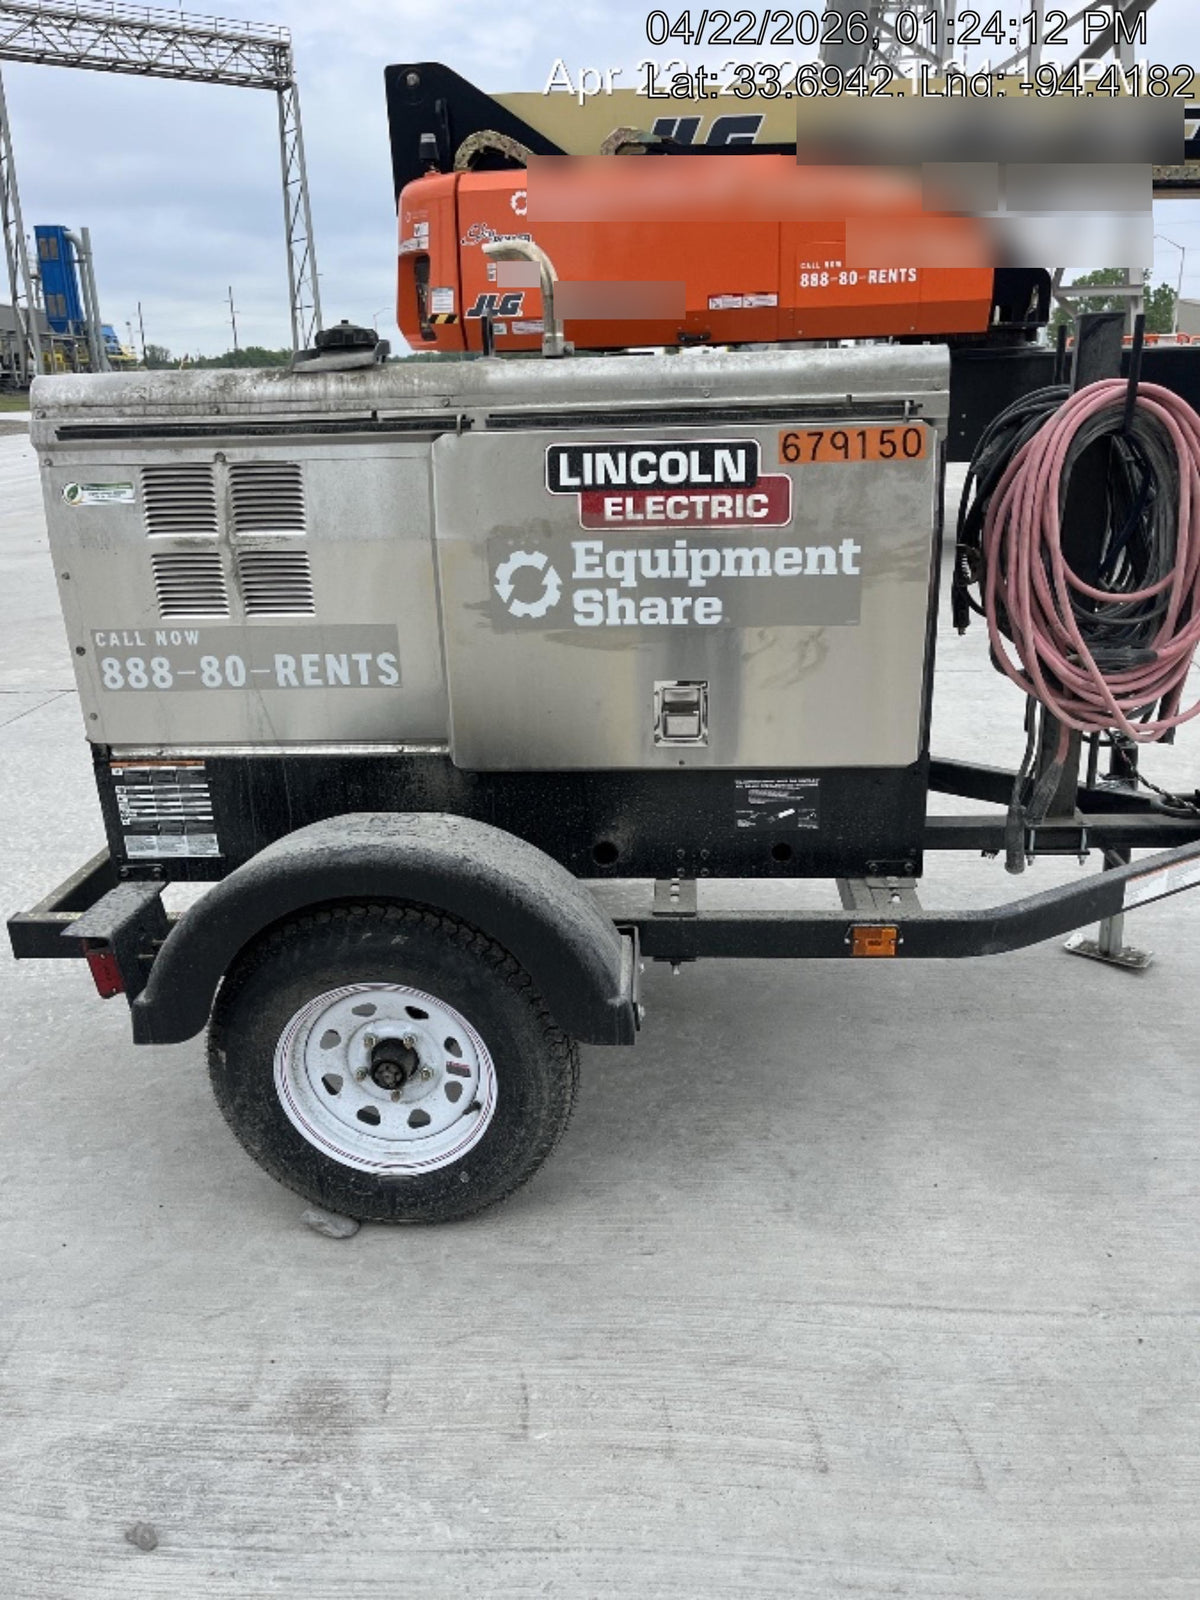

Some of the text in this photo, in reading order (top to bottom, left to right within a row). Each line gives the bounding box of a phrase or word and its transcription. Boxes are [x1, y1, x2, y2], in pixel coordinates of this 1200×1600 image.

[799, 267, 918, 288] 888-80-RENTS
[464, 292, 525, 319] JLG
[781, 428, 923, 463] 679150
[558, 449, 746, 487] LINCOLN
[603, 492, 769, 522] ELECTRIC
[570, 537, 862, 588] Equipment
[572, 588, 724, 627] Share
[95, 629, 200, 647] CALL NOW
[101, 651, 400, 690] 888-80-RENTS
